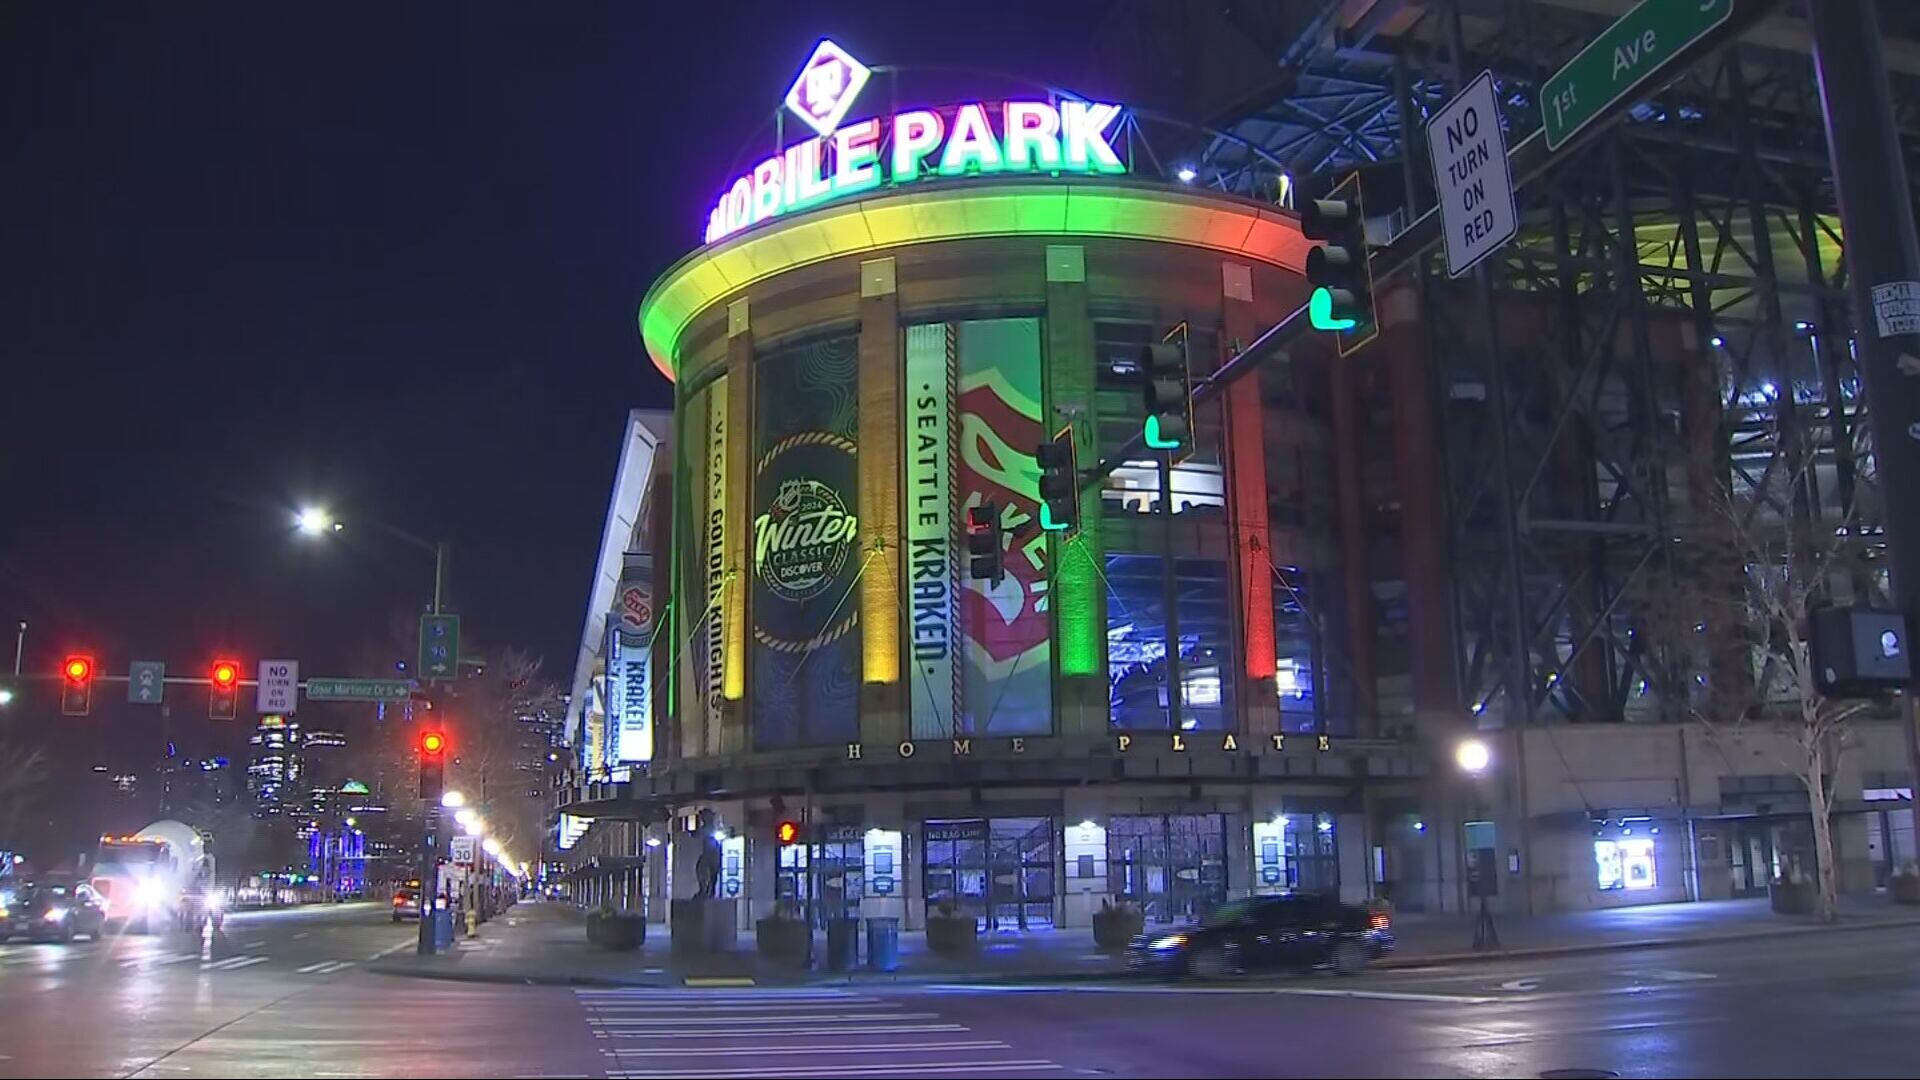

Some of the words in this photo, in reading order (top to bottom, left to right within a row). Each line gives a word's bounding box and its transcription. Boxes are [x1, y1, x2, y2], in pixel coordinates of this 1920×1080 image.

[1552, 82, 1577, 129] 1st
[1612, 29, 1656, 81] Ave
[892, 100, 1127, 182] PARK
[1447, 106, 1478, 154] NO
[1448, 139, 1489, 187] TURN
[1463, 178, 1485, 212] ON
[1463, 209, 1494, 248] RED
[713, 421, 723, 500] VEGAS
[917, 396, 939, 526] SEATTLE
[710, 509, 724, 599] GOLDEN
[755, 504, 857, 578] Winter
[773, 545, 833, 564] CLASSIC
[780, 561, 824, 578] DISCOVER
[913, 537, 947, 662] KRAKEN
[269, 665, 288, 677] NO
[710, 605, 723, 709] KNIGHTS
[626, 660, 645, 731] KRAKEN
[847, 737, 1024, 759] HOME
[1117, 734, 1330, 751] PLATE
[455, 850, 471, 861] 30
